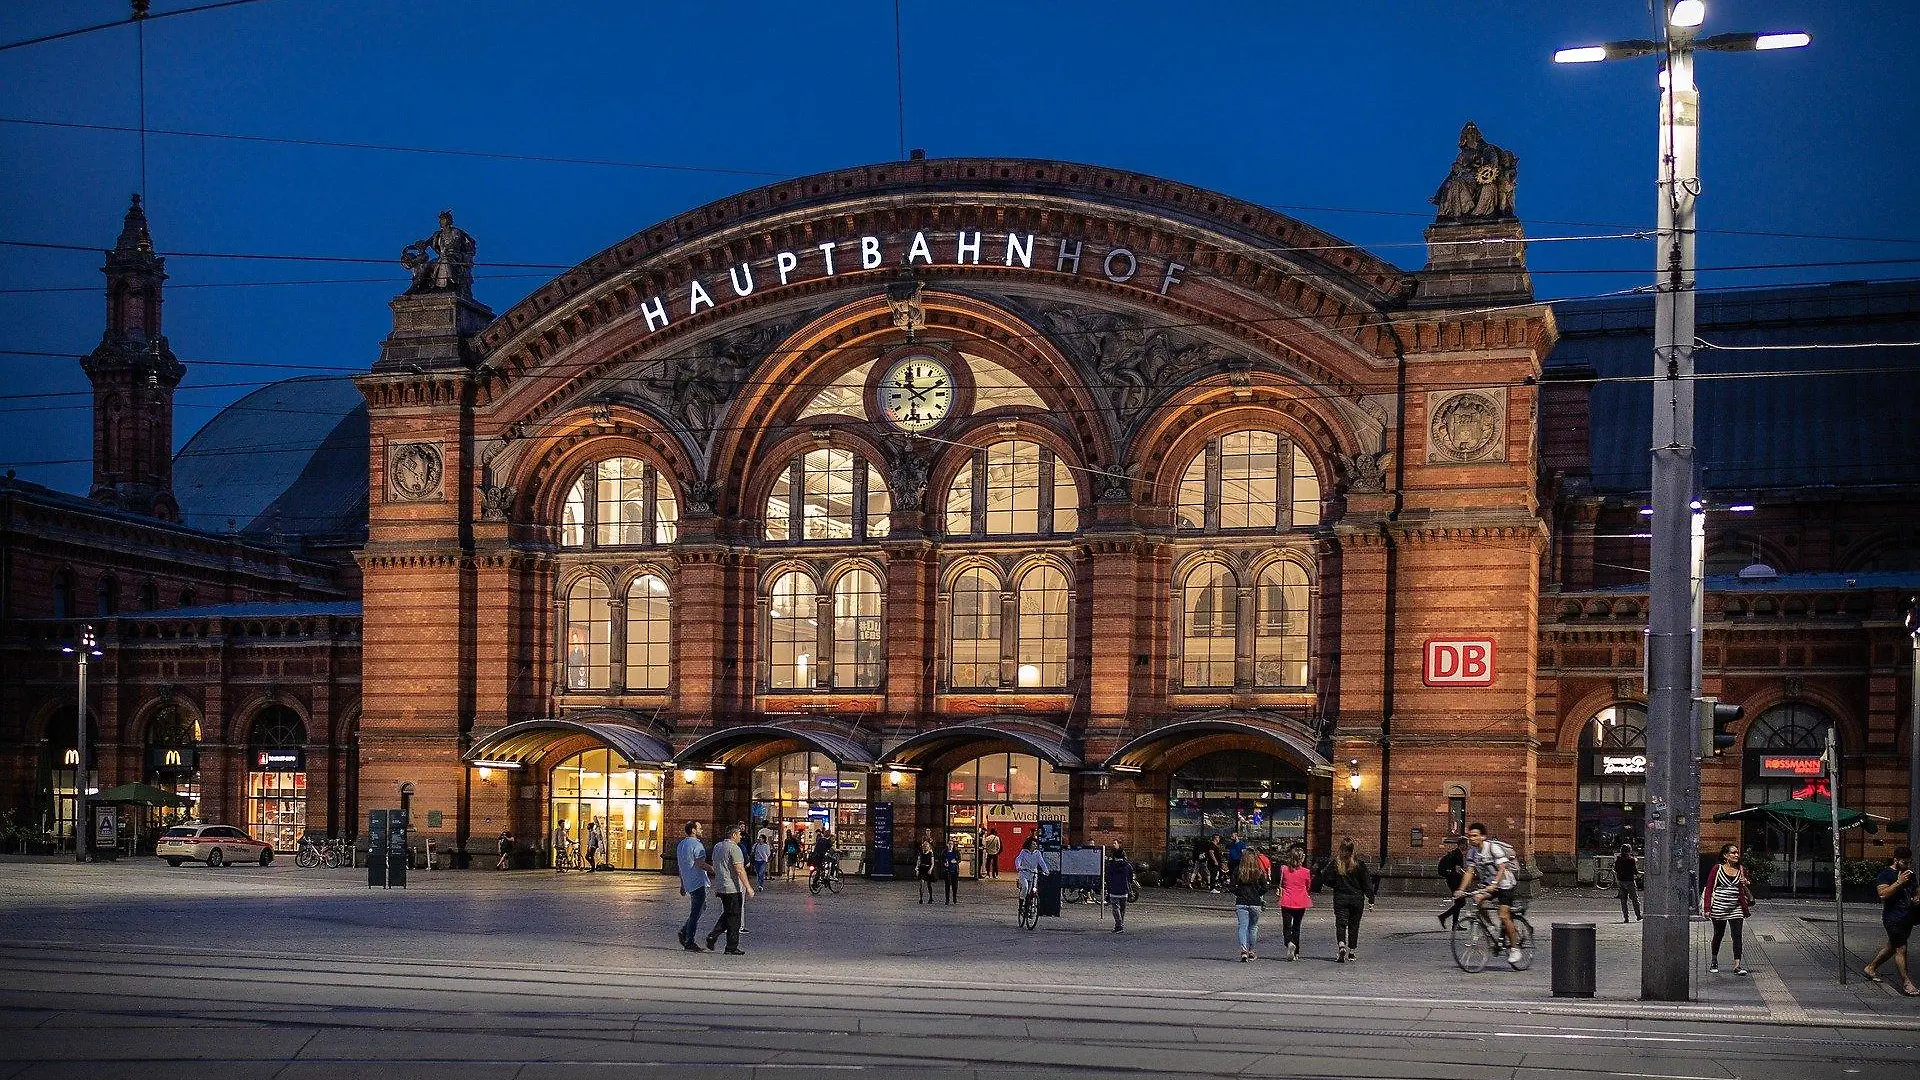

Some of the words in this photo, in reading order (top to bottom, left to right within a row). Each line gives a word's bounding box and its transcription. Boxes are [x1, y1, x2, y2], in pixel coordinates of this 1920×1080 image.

[641, 231, 1185, 332] HAUPTBAHNHOF
[1434, 645, 1487, 677] DB
[1765, 759, 1821, 768] ROSSMANN
